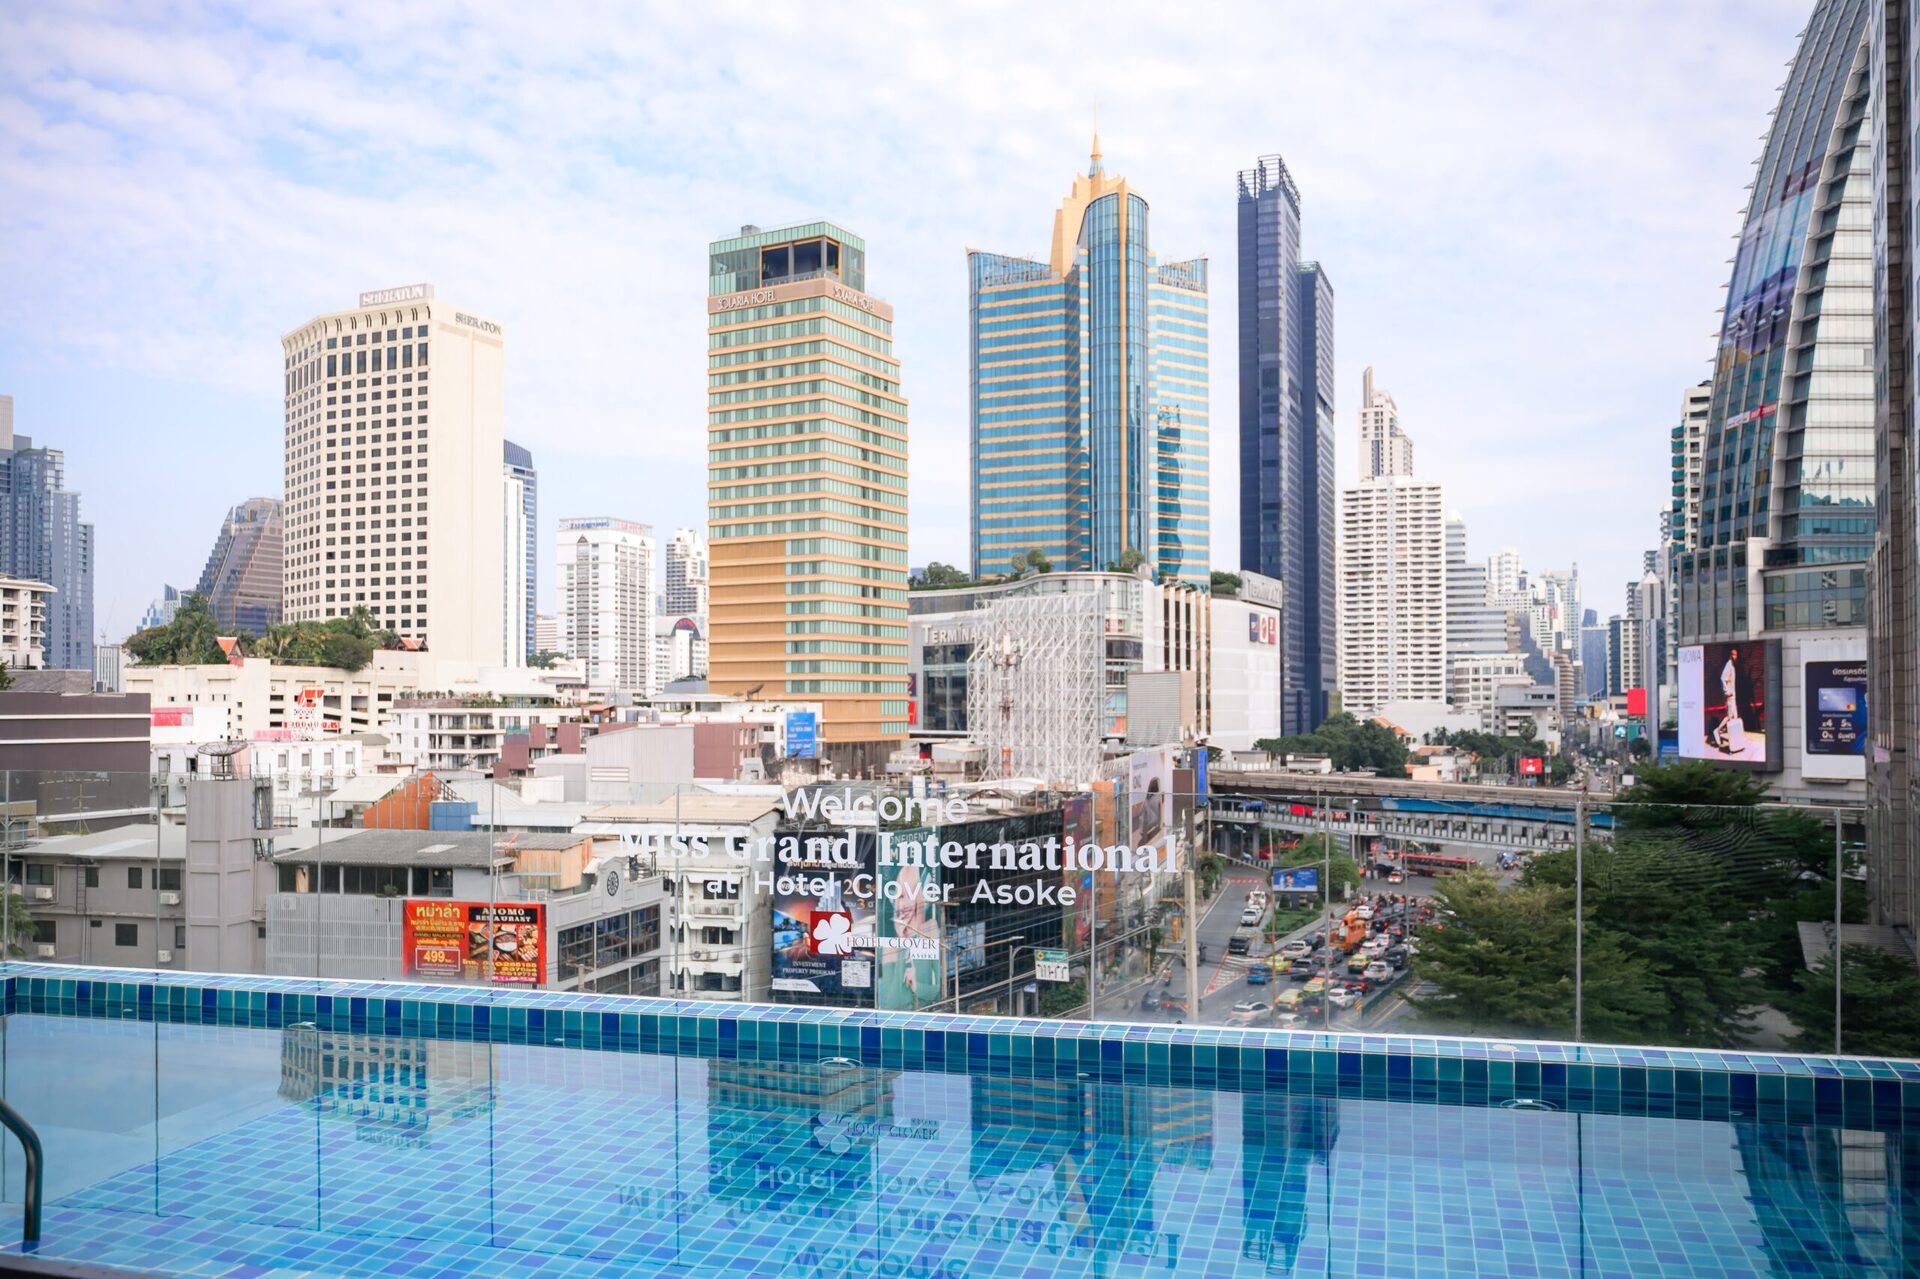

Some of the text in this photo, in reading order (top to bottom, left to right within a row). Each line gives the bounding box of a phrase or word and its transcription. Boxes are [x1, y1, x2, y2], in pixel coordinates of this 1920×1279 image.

[718, 290, 777, 311] SOLARIA HOTEL
[833, 286, 875, 312] SOLARIA HOTEL
[455, 312, 502, 336] SHERATON
[781, 788, 969, 823] Welcome
[617, 829, 710, 859] Miss
[725, 828, 858, 866] Grand
[878, 832, 1179, 873] International
[706, 872, 737, 895] at
[754, 870, 835, 899] Hotel
[854, 873, 955, 903] Clover
[970, 878, 1077, 906] Asoke
[416, 902, 460, 919] หม่าล่า
[475, 915, 532, 923] RESAURANT
[847, 937, 937, 950] HOTEL CLOVER
[424, 950, 445, 963] 499
[792, 960, 827, 969] INVESTMENT
[782, 967, 836, 977] PROPERTY PROGRAM
